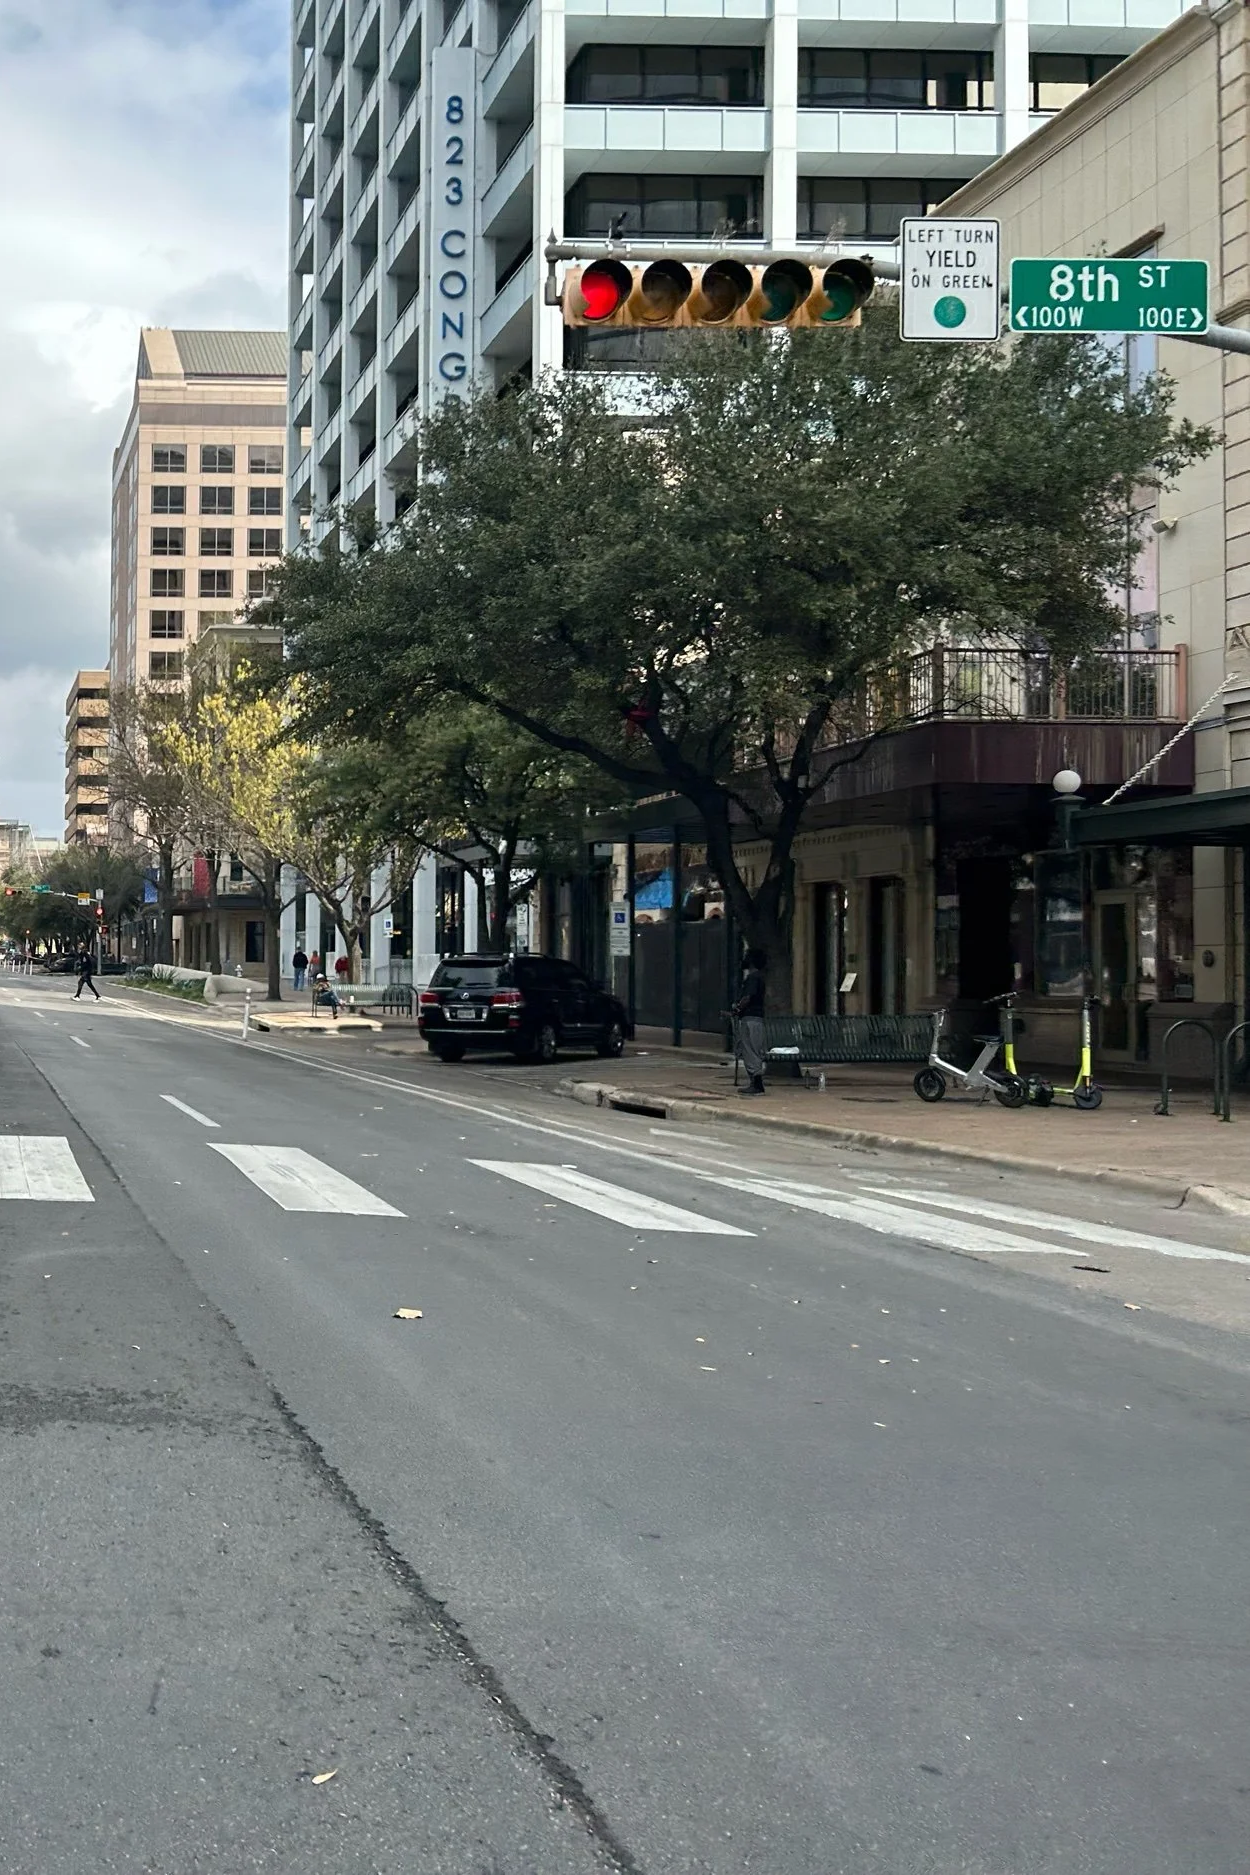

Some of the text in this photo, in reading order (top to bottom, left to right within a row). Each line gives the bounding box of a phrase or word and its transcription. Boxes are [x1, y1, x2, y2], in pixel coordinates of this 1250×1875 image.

[445, 95, 464, 206] 823
[908, 229, 993, 243] LEFT TURN
[926, 250, 976, 268] YIELD
[911, 274, 991, 288] ON GREEN
[1049, 264, 1170, 302] 8th ST
[1031, 306, 1187, 328] 100W 100E
